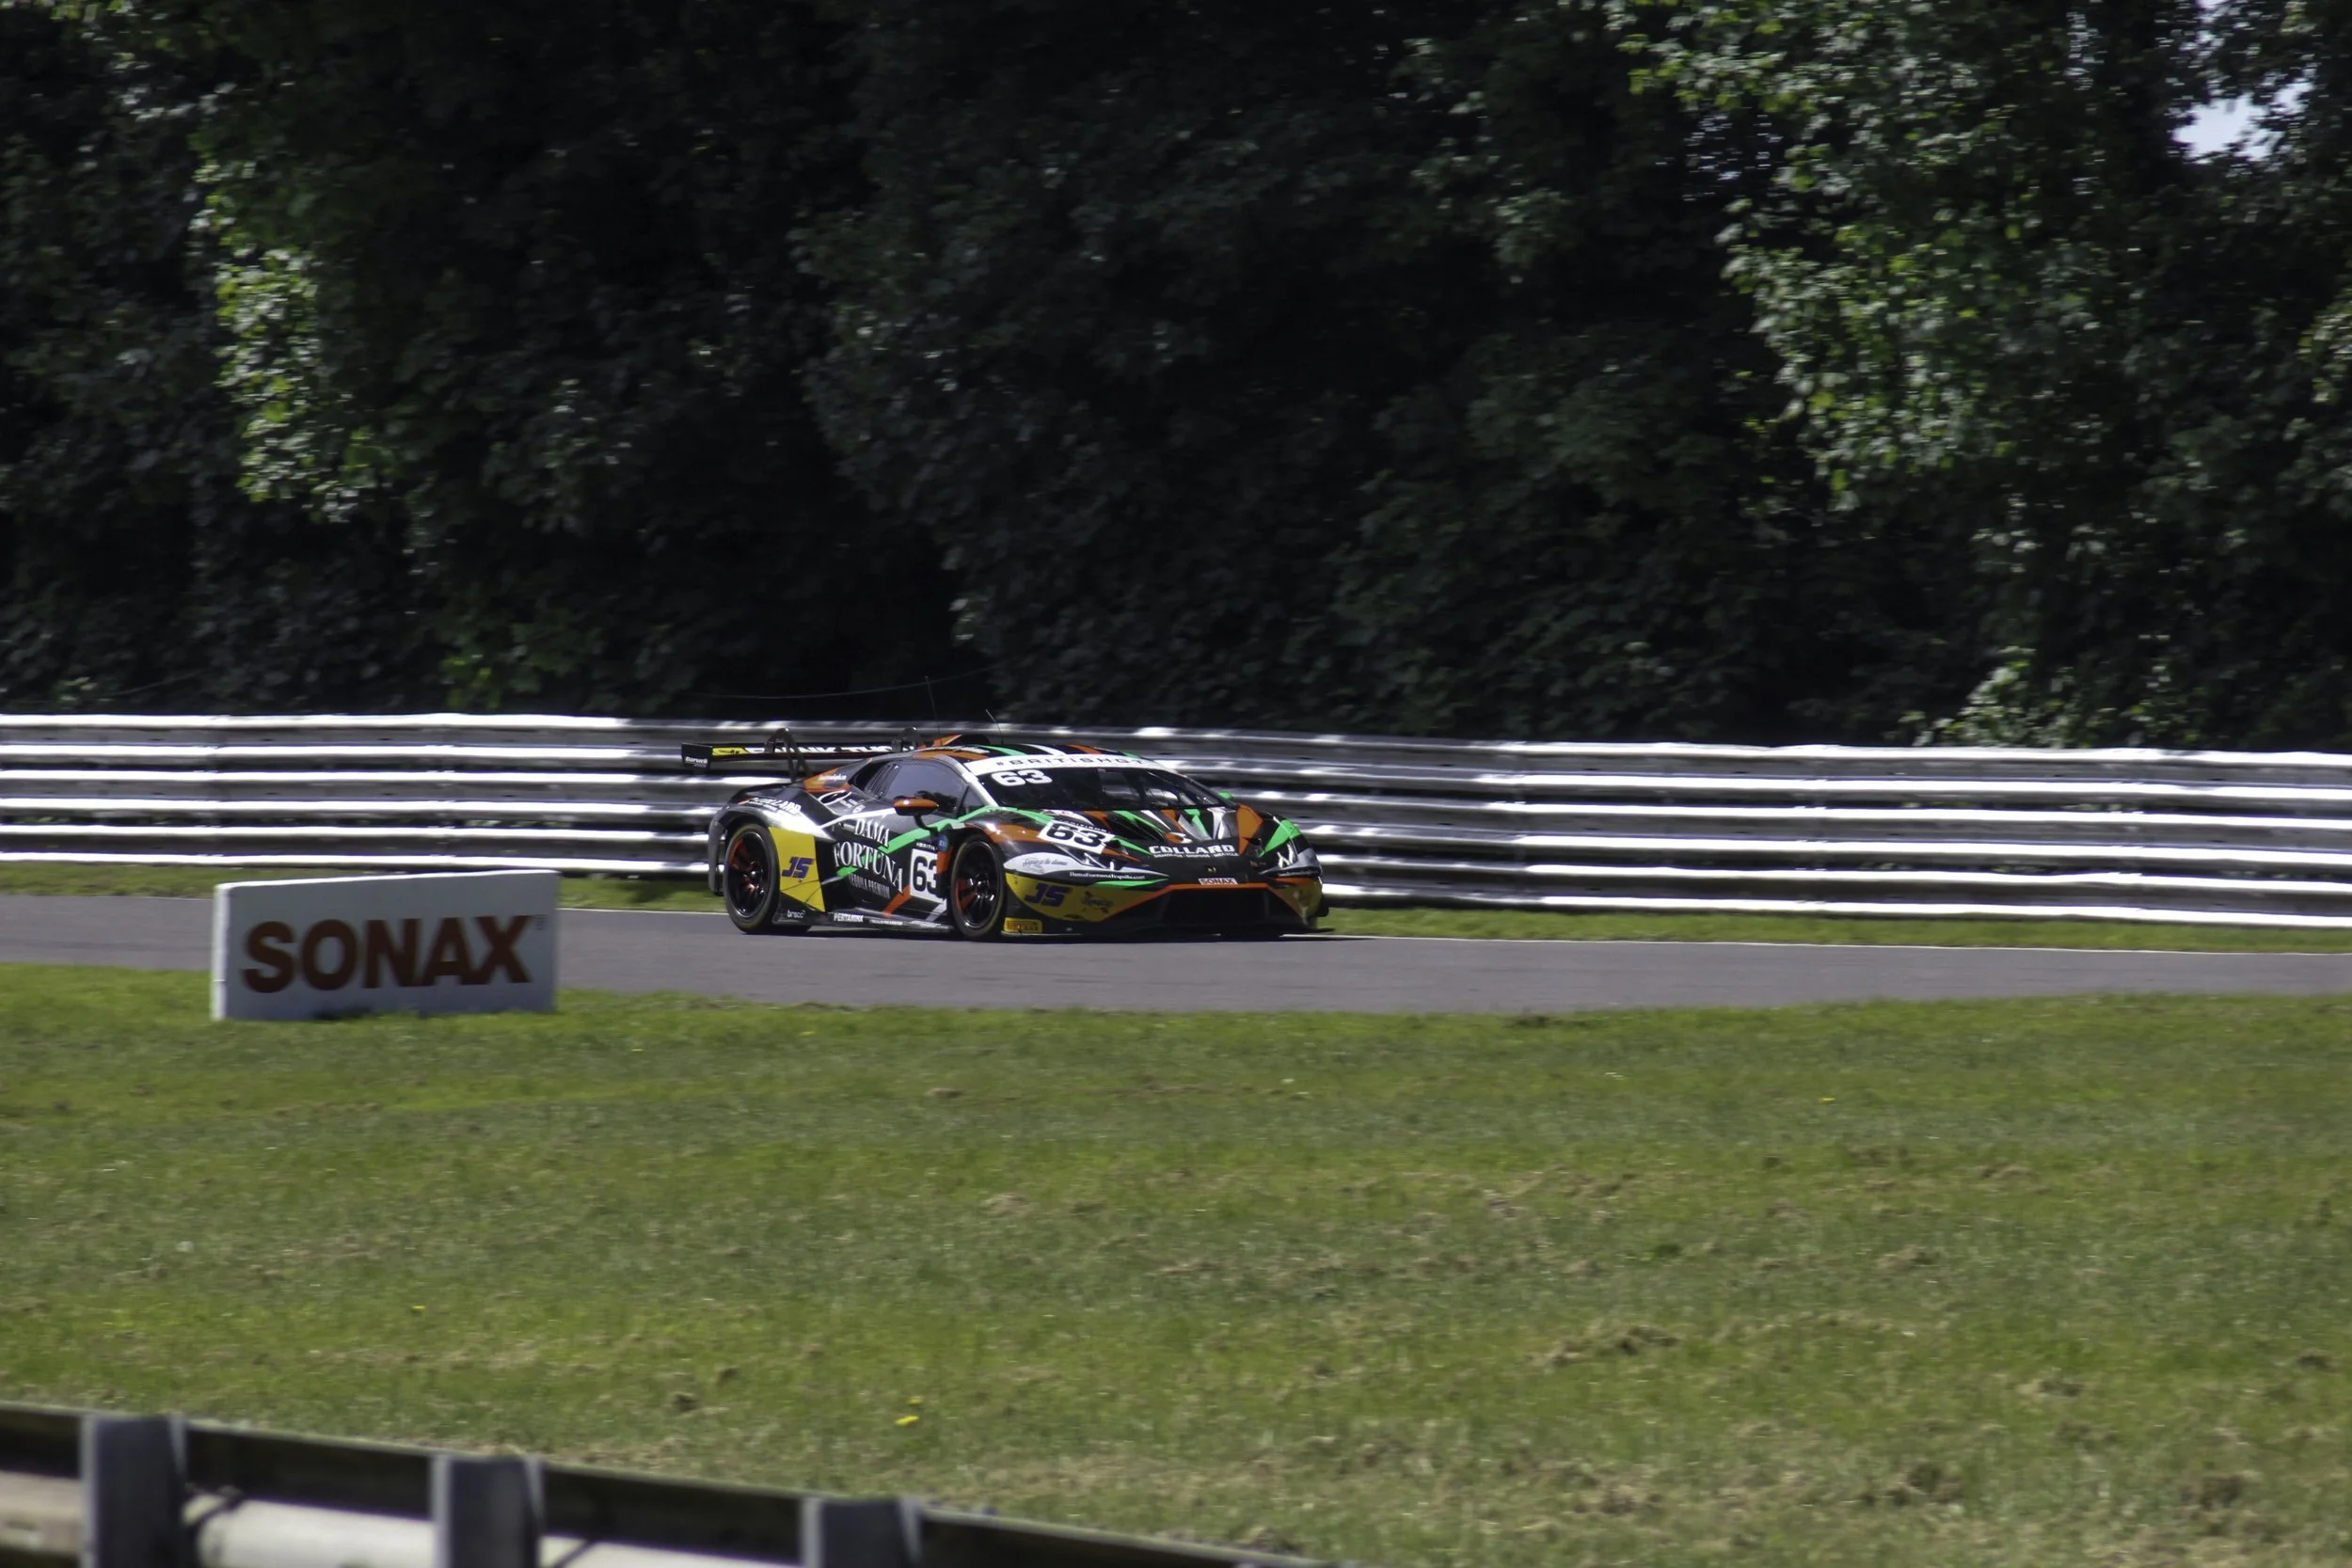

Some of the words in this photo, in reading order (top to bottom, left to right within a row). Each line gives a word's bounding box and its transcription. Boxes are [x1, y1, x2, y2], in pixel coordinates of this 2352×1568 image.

[995, 757, 1145, 767] #BRITISHGT
[991, 768, 1053, 787] 63
[853, 817, 890, 849] DAMA
[1045, 821, 1106, 847] 63
[1149, 845, 1236, 855] COLLARD
[833, 840, 904, 895] FORTUNA
[242, 914, 532, 993] SONAX
